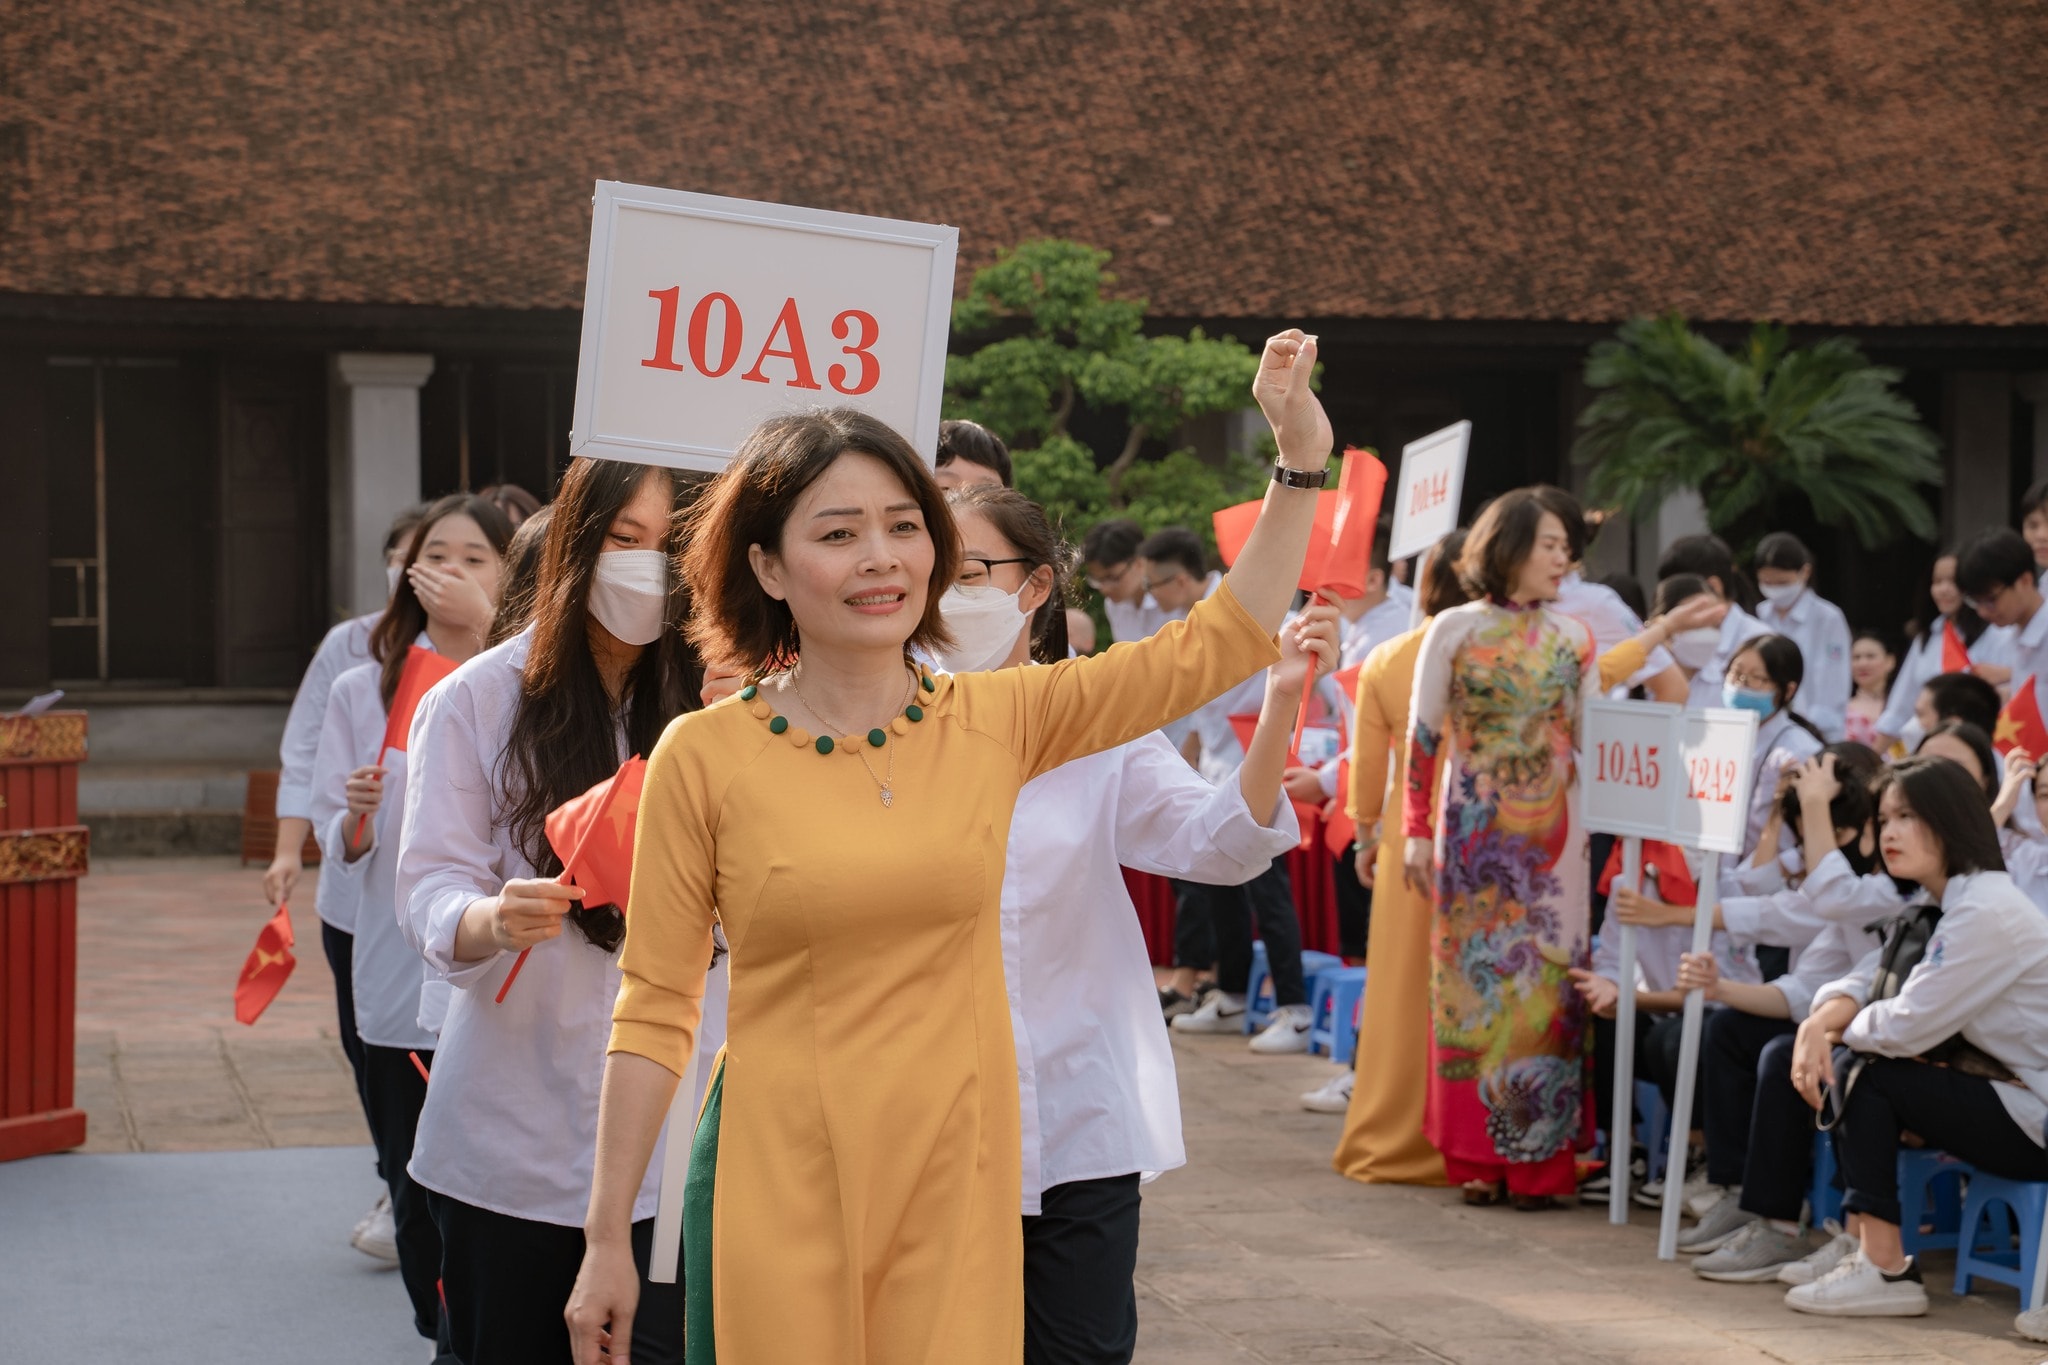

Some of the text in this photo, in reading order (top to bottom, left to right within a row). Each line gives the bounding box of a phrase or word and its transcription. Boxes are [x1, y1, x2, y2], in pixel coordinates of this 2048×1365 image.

[641, 285, 881, 395] 10A3
[1596, 740, 1661, 789] 10A5
[1687, 757, 1737, 802] 12A2
